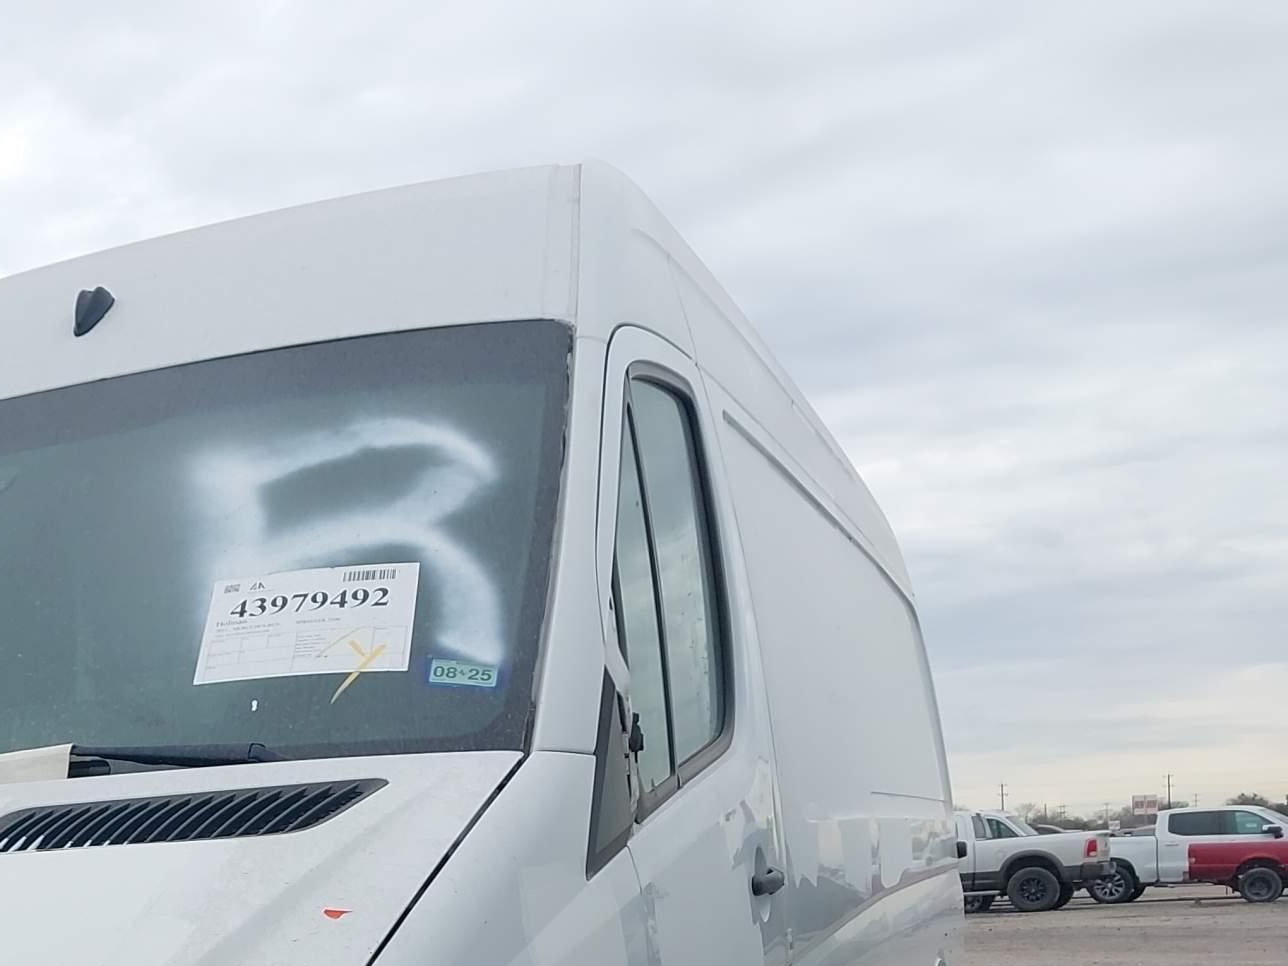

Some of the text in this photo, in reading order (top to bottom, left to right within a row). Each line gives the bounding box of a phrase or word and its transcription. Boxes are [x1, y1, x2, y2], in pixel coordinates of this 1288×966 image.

[230, 587, 390, 618] 43979492
[433, 665, 493, 682] 08 25
